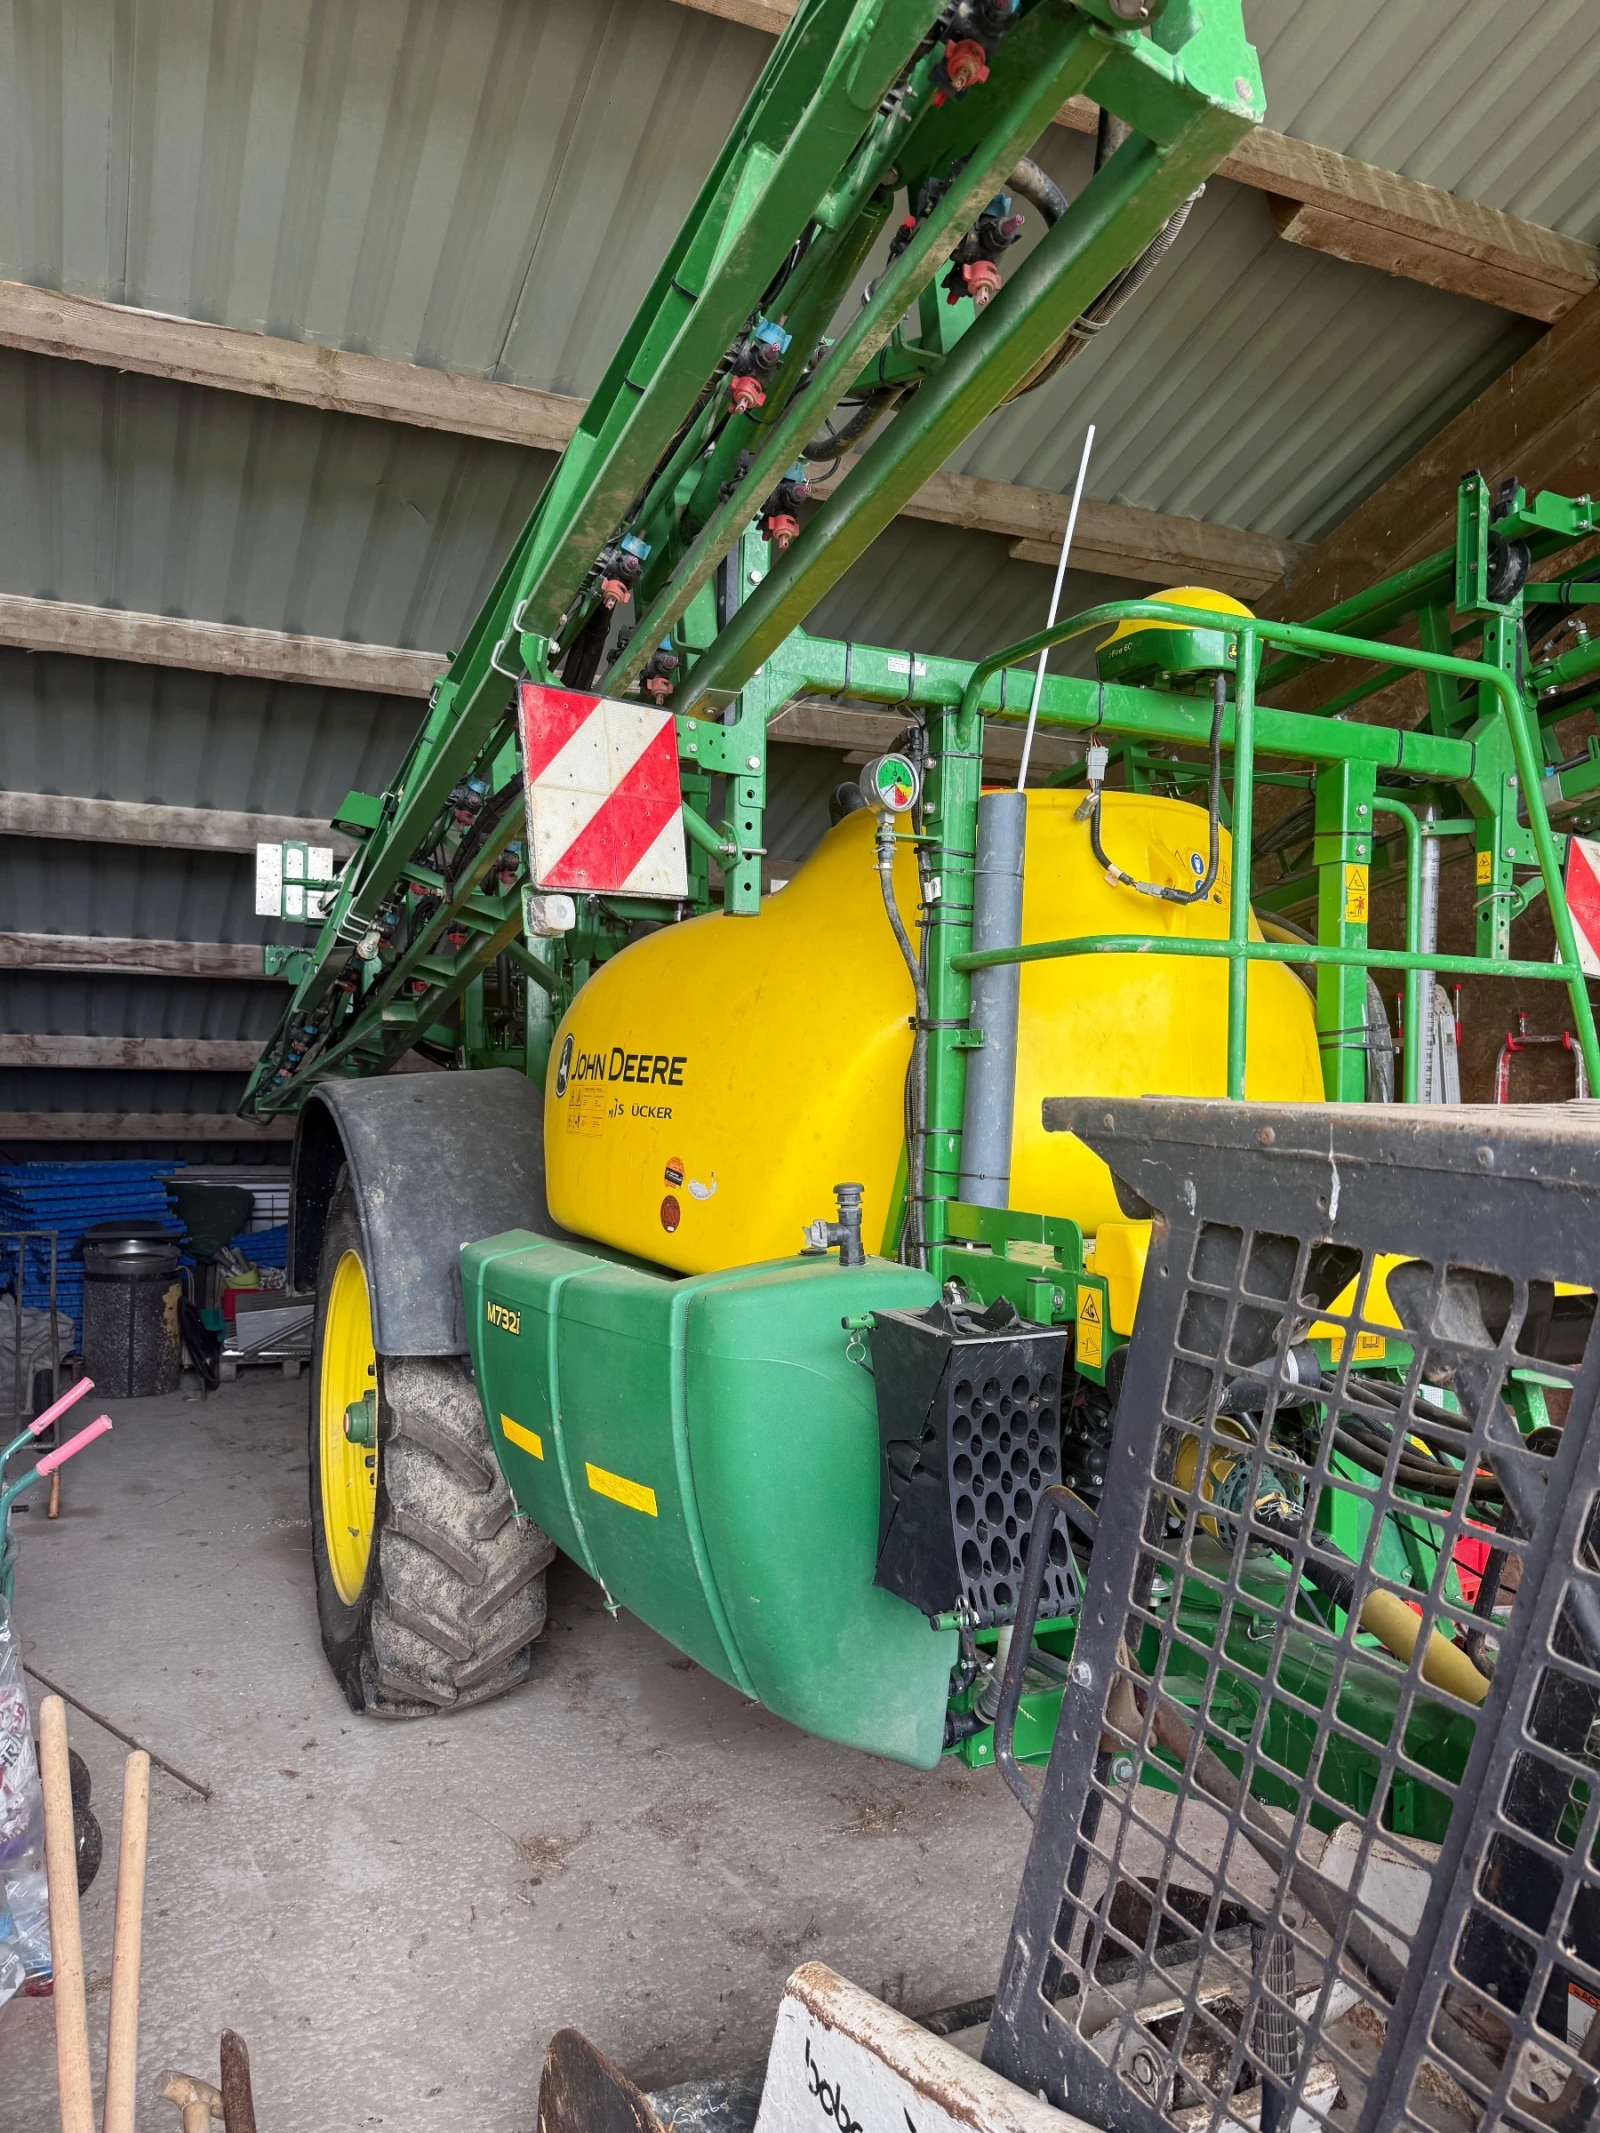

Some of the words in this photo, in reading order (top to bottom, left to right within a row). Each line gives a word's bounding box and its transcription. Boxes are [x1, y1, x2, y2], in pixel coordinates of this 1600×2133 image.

[571, 1048, 607, 1081] JOHN
[608, 1047, 688, 1086] DEERE
[631, 1103, 673, 1119] ÜCKER
[487, 1301, 520, 1335] M732i
